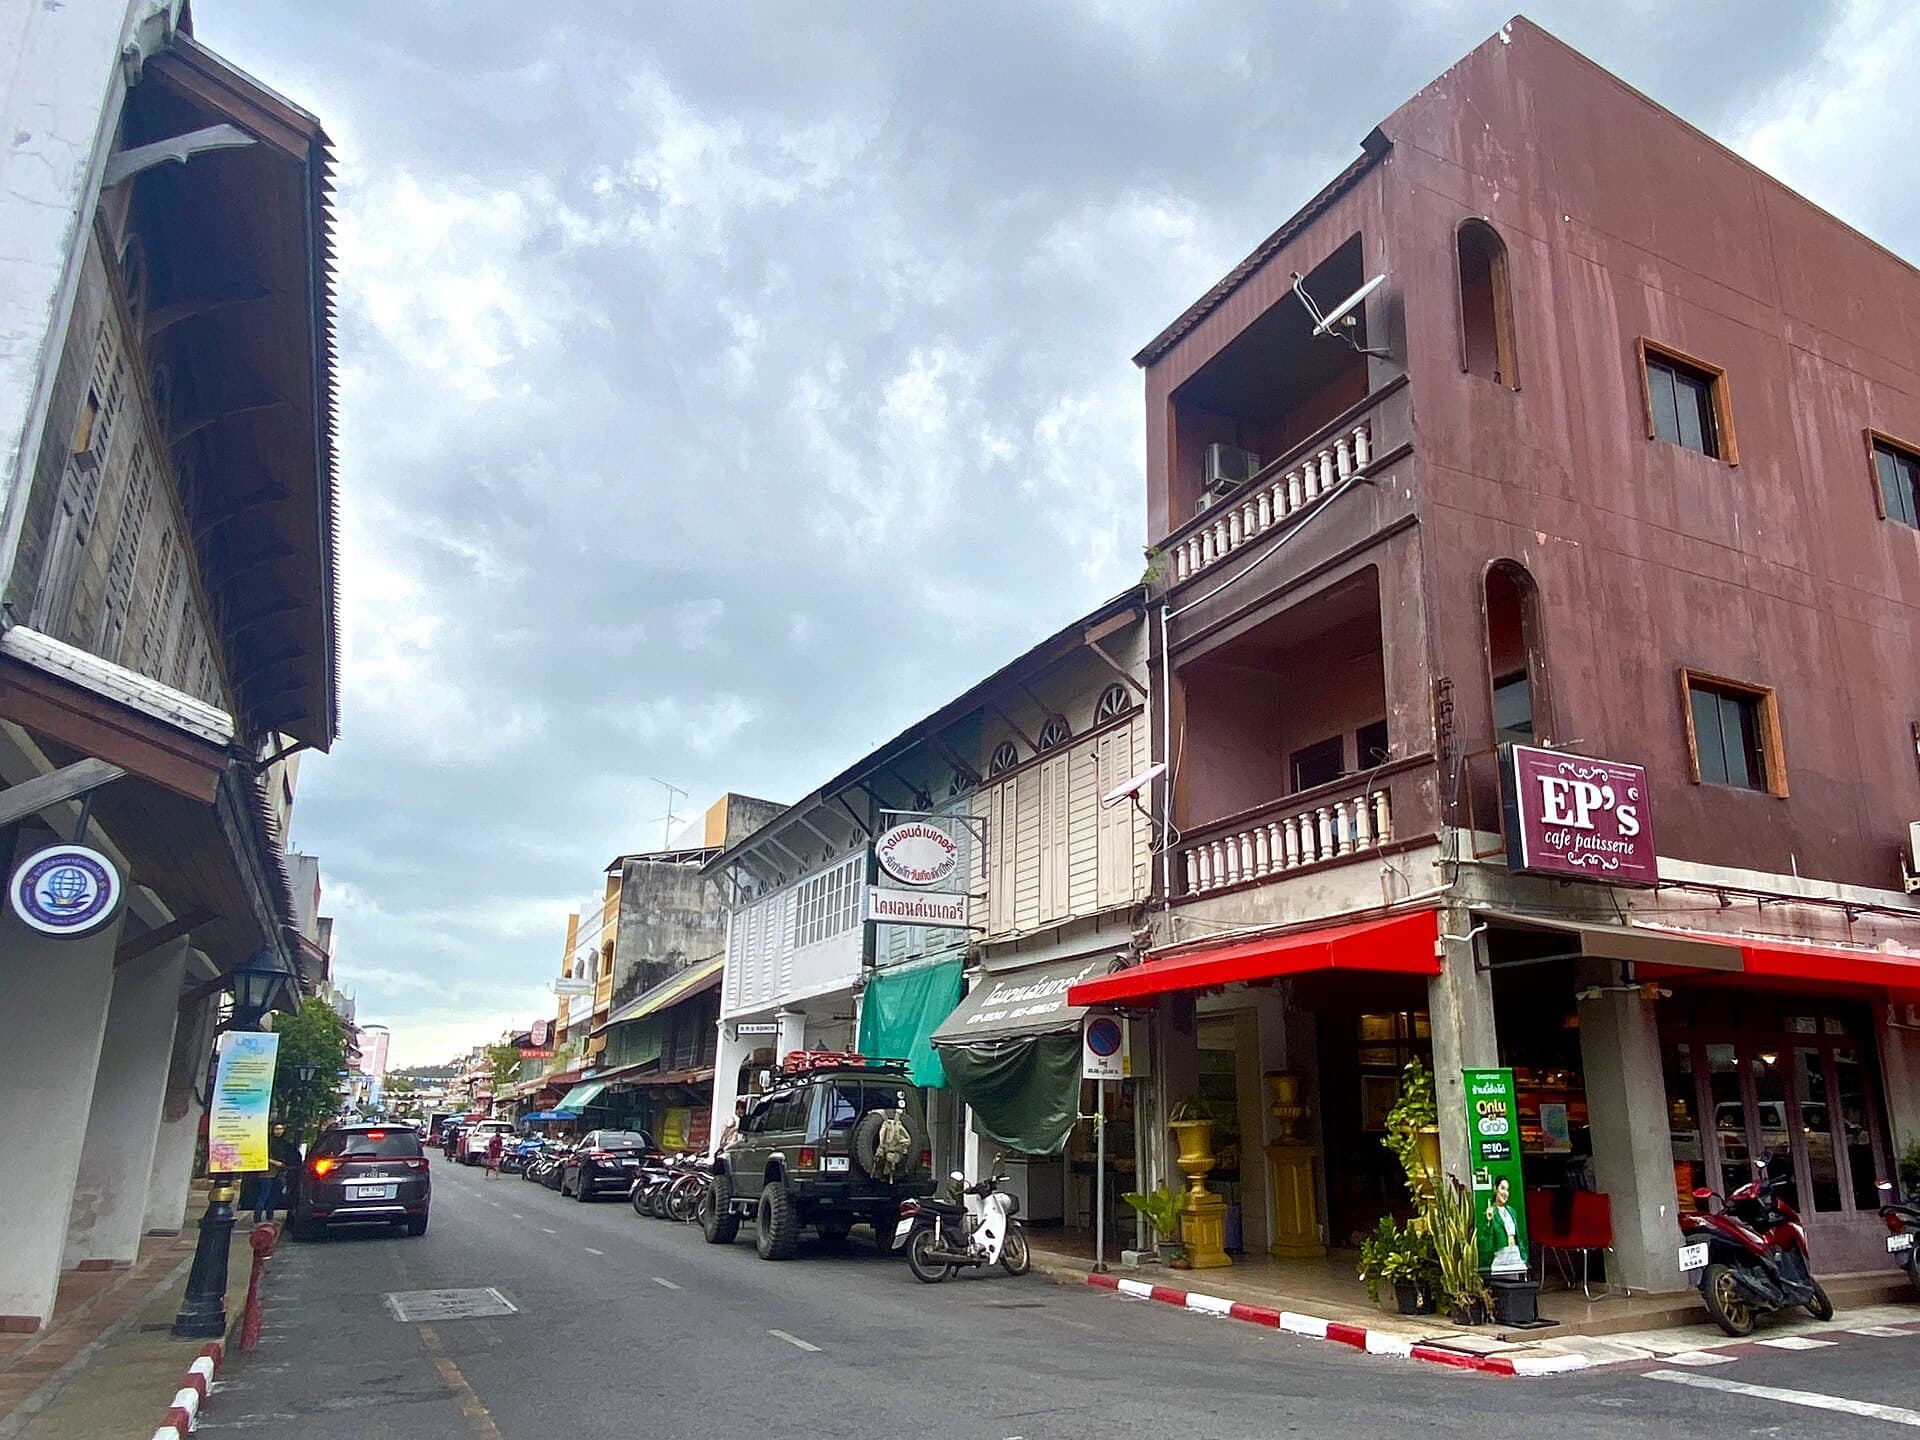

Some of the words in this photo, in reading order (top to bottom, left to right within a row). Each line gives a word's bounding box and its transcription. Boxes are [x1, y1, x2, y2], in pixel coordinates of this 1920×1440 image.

[1544, 828, 1571, 850] cafe
[1575, 833, 1634, 855] patisserie
[1476, 1099, 1507, 1116] Only
[1481, 1120, 1507, 1132] Grab
